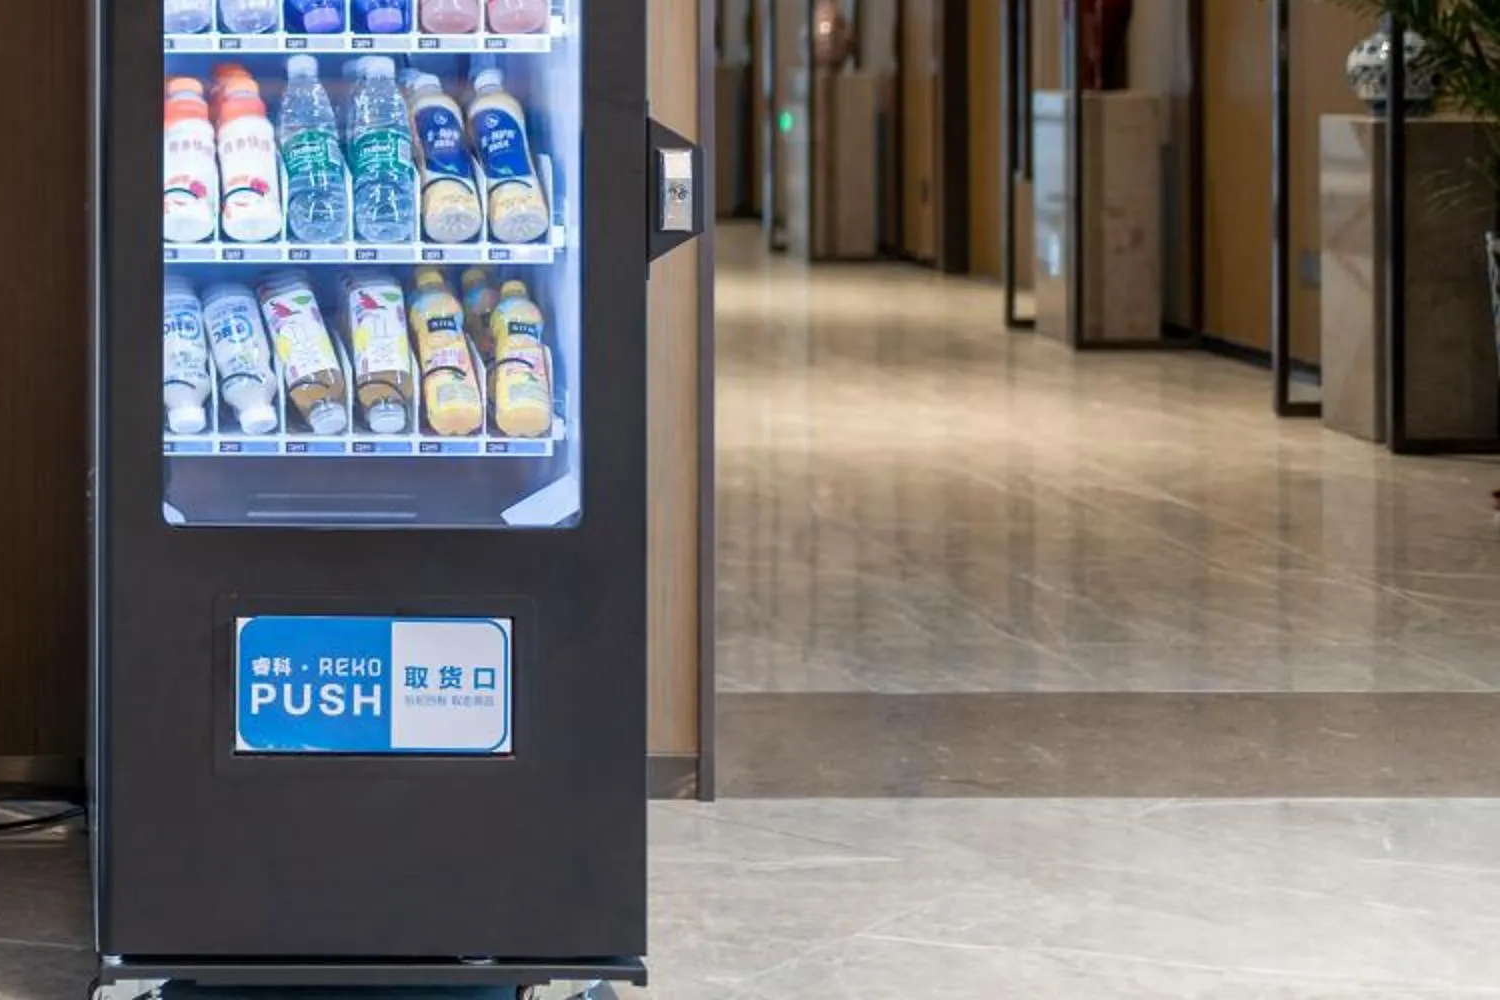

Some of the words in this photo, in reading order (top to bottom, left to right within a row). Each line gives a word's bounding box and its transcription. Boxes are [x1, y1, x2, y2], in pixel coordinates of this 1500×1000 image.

[318, 657, 382, 677] REKO
[404, 665, 497, 691] 取货口
[250, 683, 382, 717] PUSH
